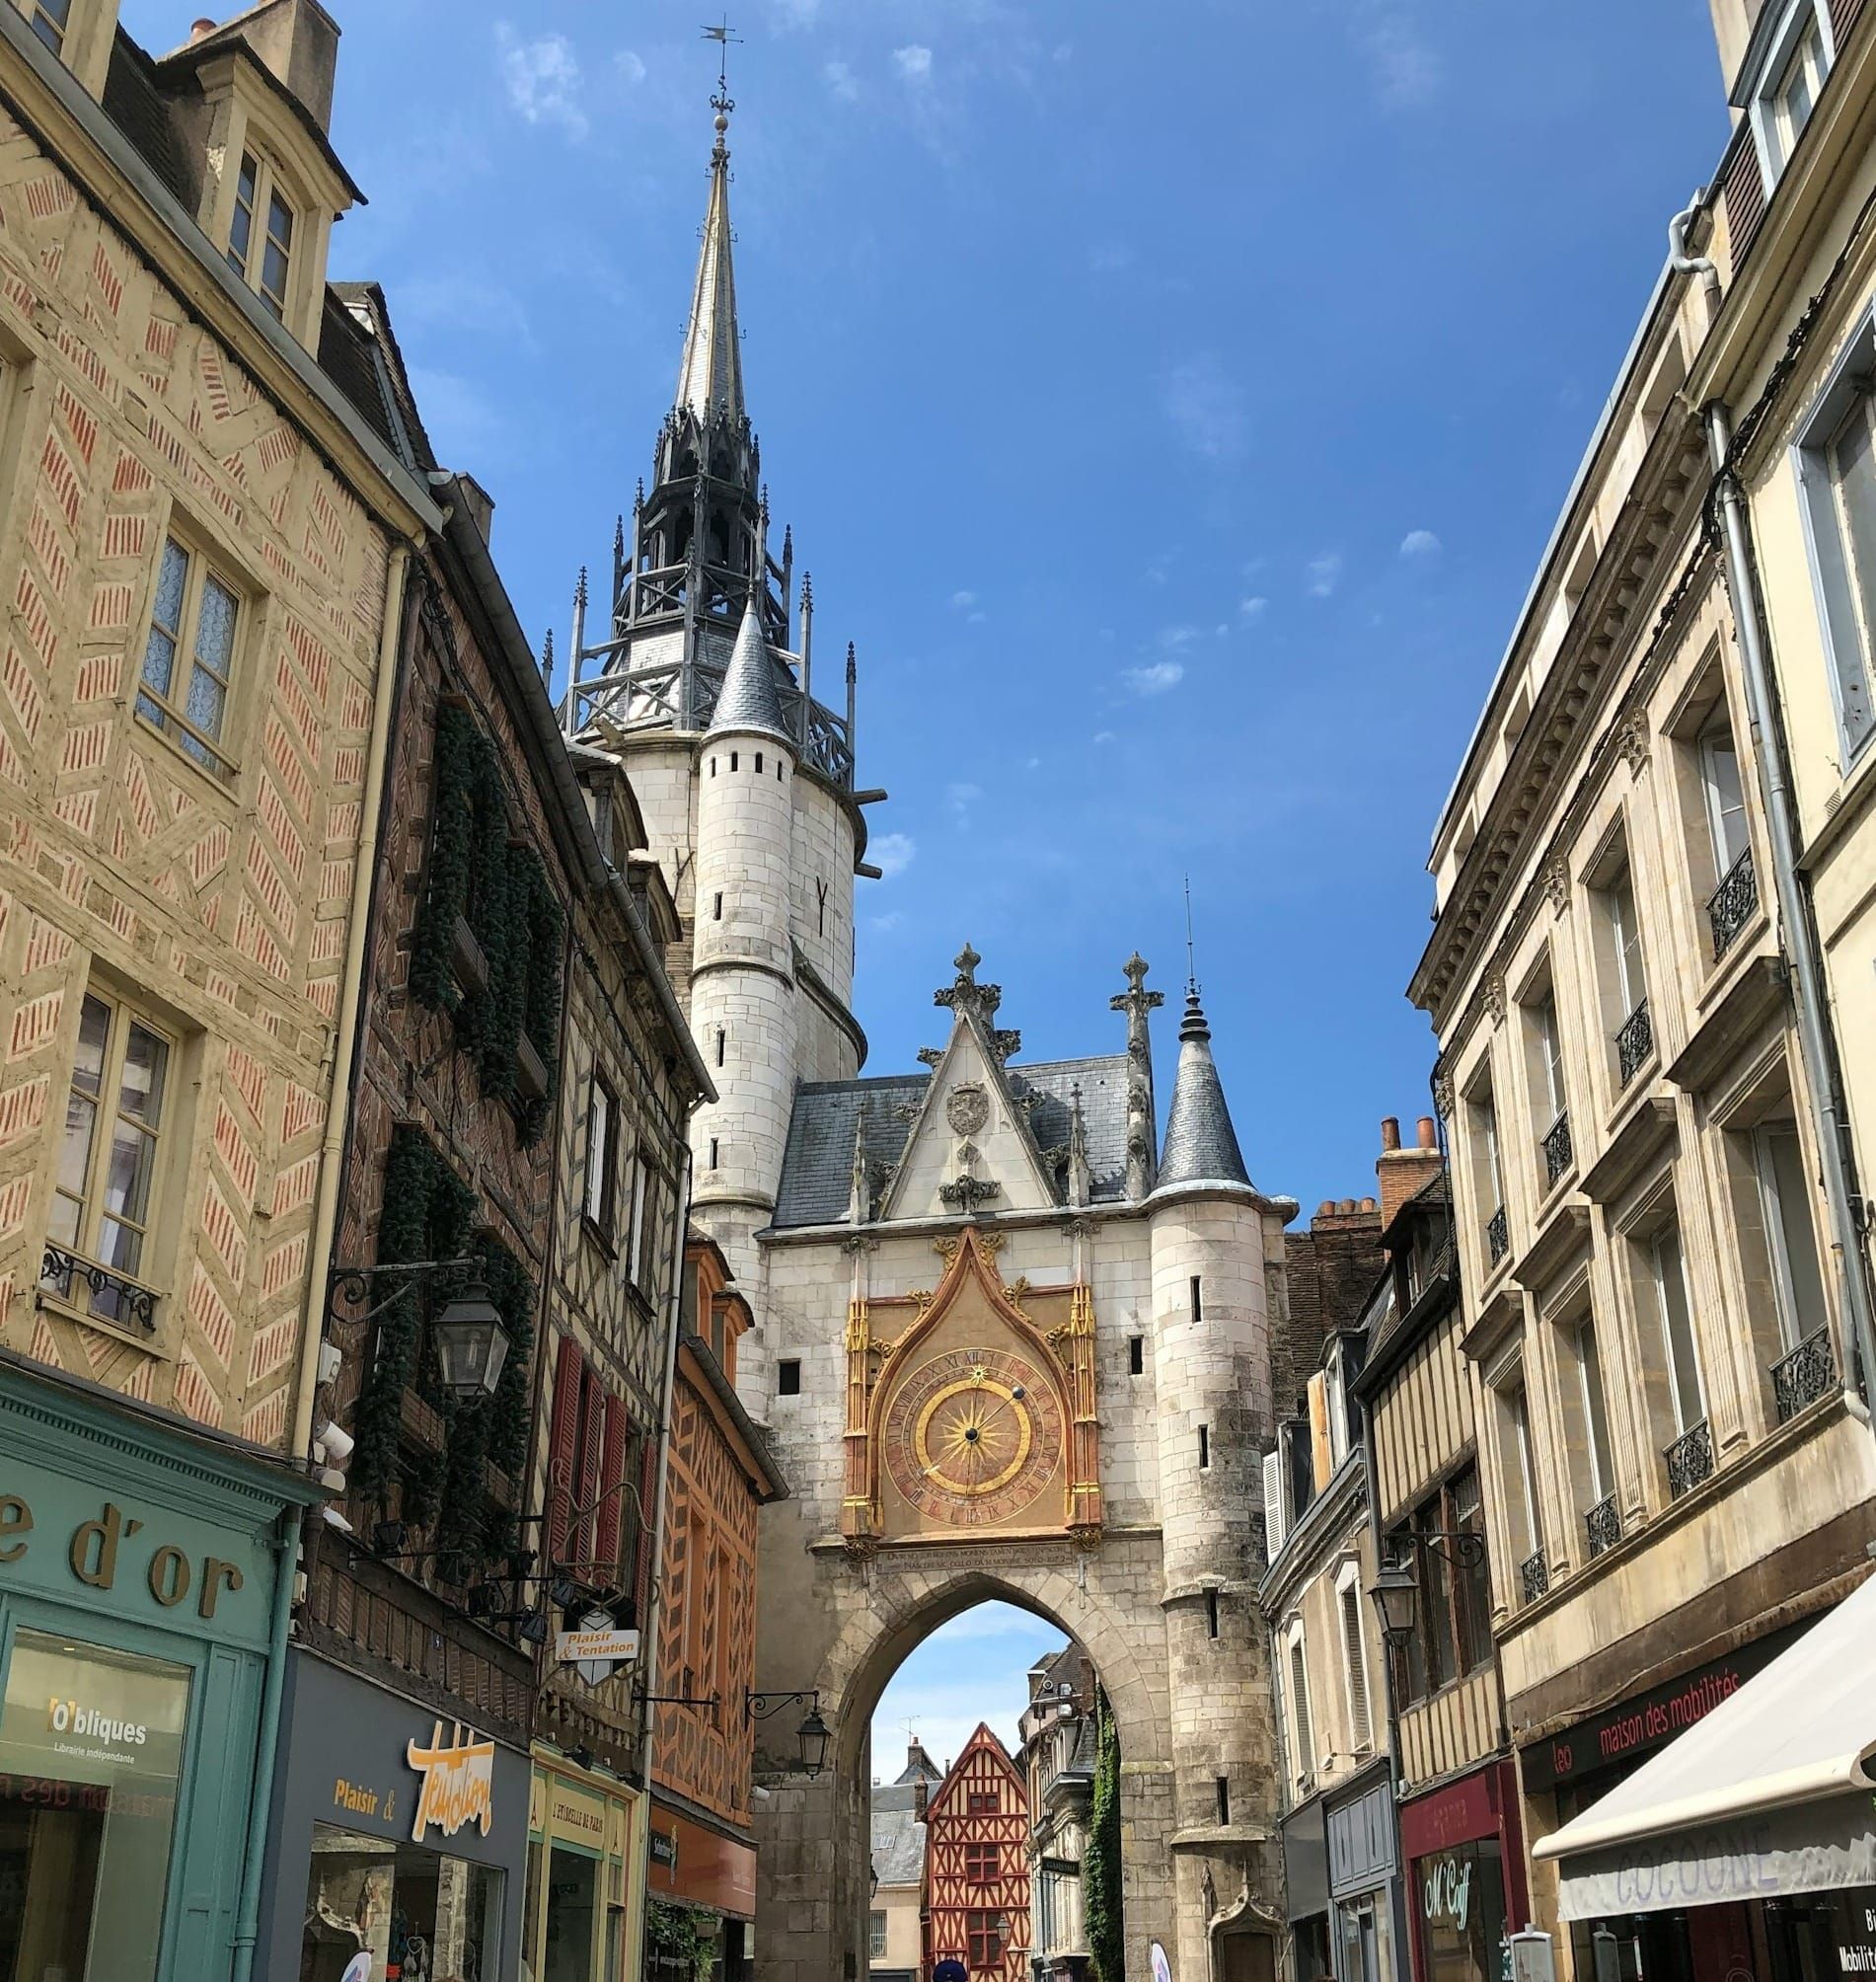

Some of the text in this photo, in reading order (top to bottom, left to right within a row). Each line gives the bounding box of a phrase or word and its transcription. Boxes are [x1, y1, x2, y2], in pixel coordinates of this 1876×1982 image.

[69, 1502, 245, 1619] d'or
[559, 1642, 635, 1659] & Tentation
[567, 1632, 611, 1644] Plaisir
[1600, 1716, 1645, 1757] maison
[1646, 1702, 1669, 1738] des
[54, 1742, 135, 1765] Librairie indépendante
[334, 1779, 380, 1816] Plaisir
[383, 1789, 396, 1822] &
[1839, 1945, 1876, 1972] Mobilit
